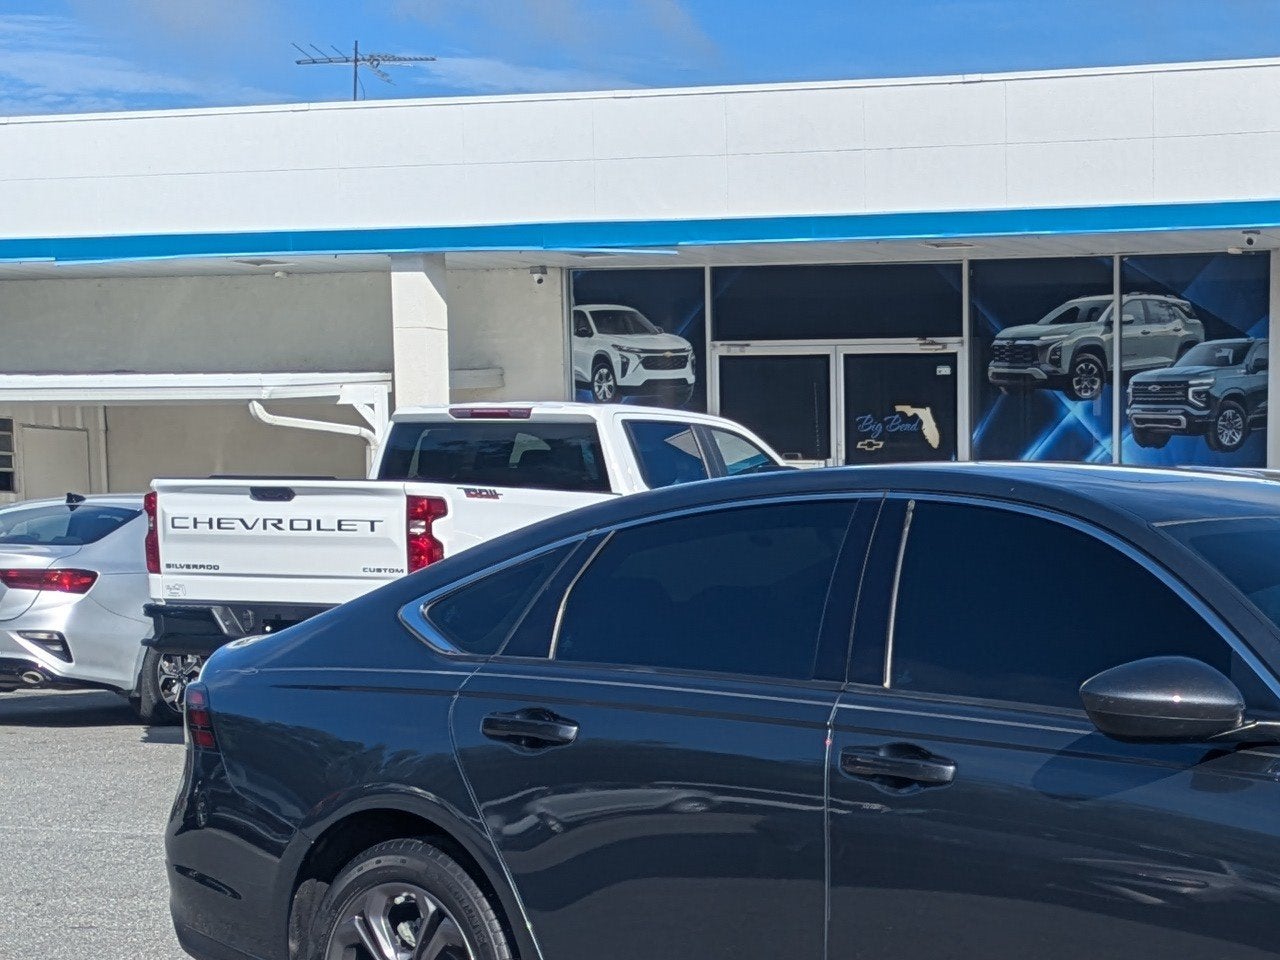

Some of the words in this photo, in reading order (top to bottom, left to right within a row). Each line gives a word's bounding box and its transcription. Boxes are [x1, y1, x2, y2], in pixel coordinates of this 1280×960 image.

[856, 414, 882, 439] Big
[884, 414, 920, 432] Bend
[171, 516, 383, 532] CHEVROLET
[165, 563, 220, 571] SILVERADO
[362, 566, 404, 574] CUSTOM
